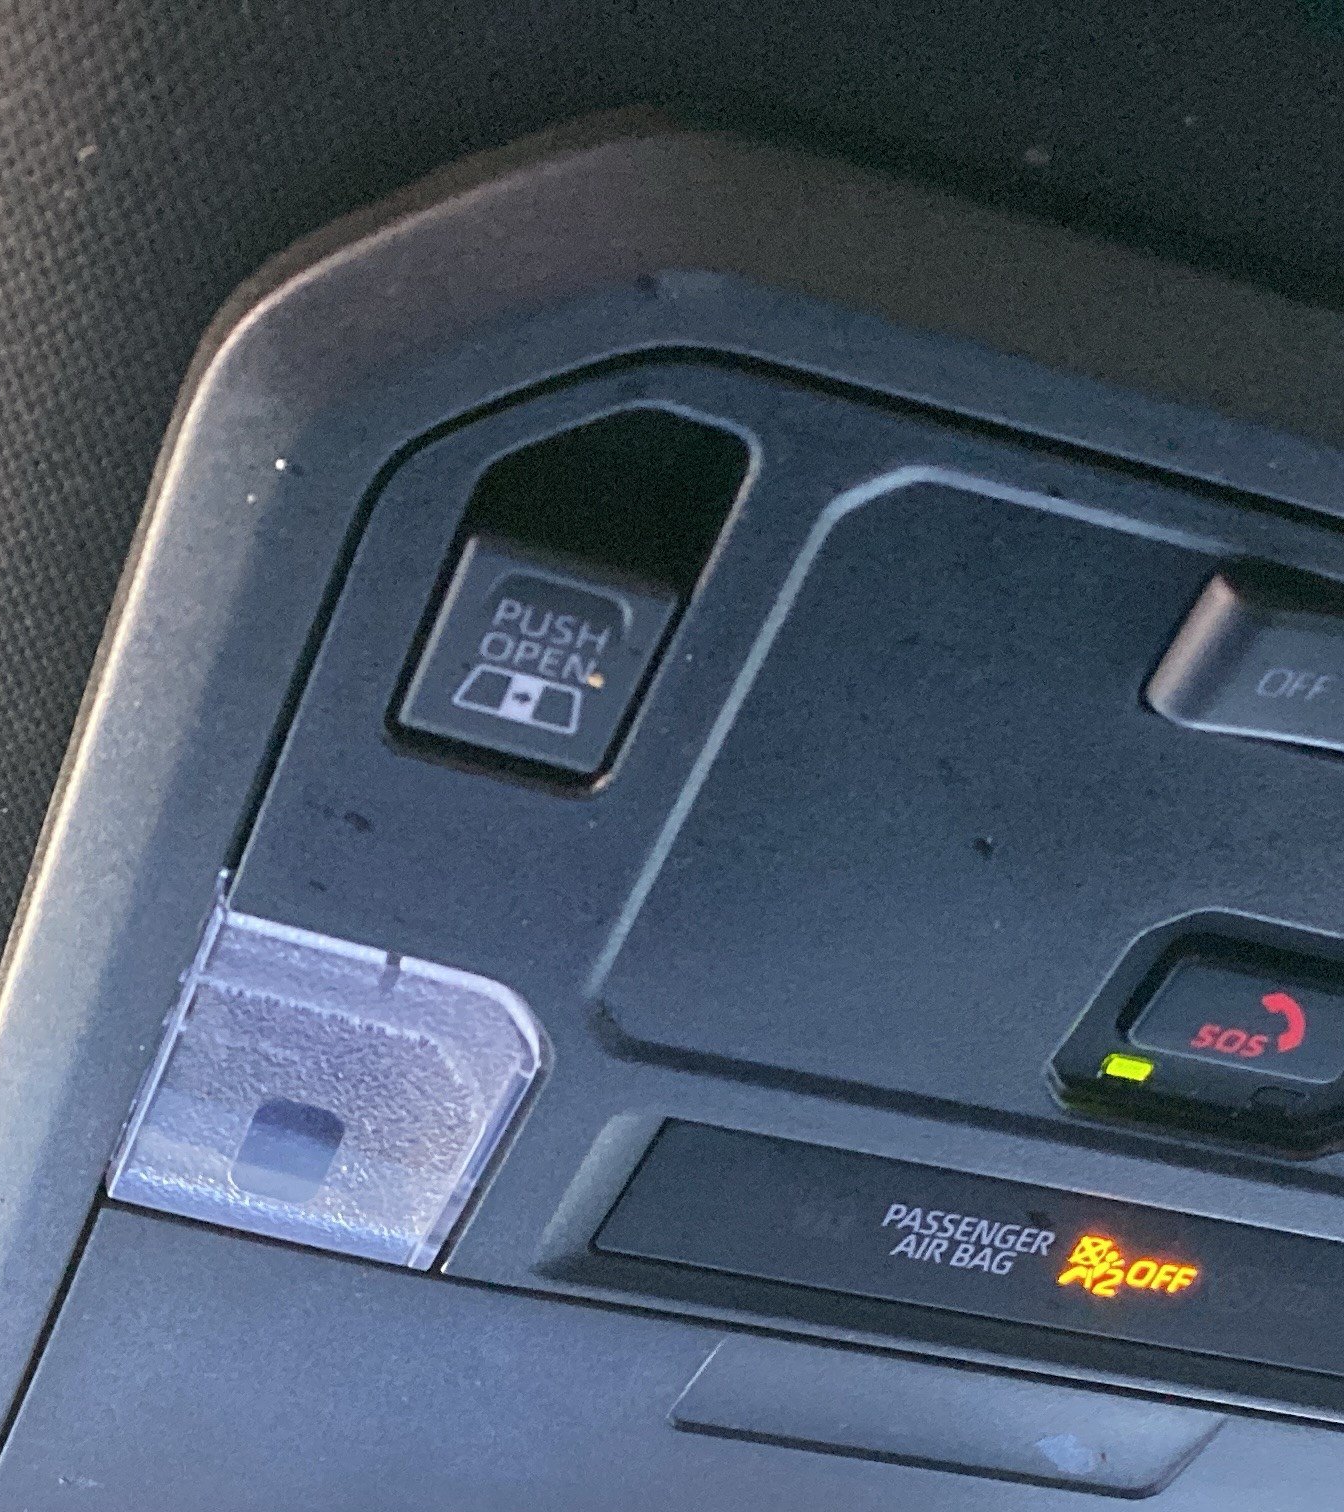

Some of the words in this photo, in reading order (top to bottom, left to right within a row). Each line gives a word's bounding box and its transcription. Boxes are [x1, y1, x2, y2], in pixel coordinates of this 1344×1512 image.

[493, 598, 612, 652] PUSH
[480, 632, 597, 684] OPEN
[1256, 668, 1331, 700] OFF
[1191, 1024, 1268, 1057] SOS
[882, 1204, 1056, 1256] PASSENGER
[891, 1235, 947, 1264] AIR
[950, 1244, 1017, 1275] BAG
[1126, 1261, 1199, 1293] OFF
